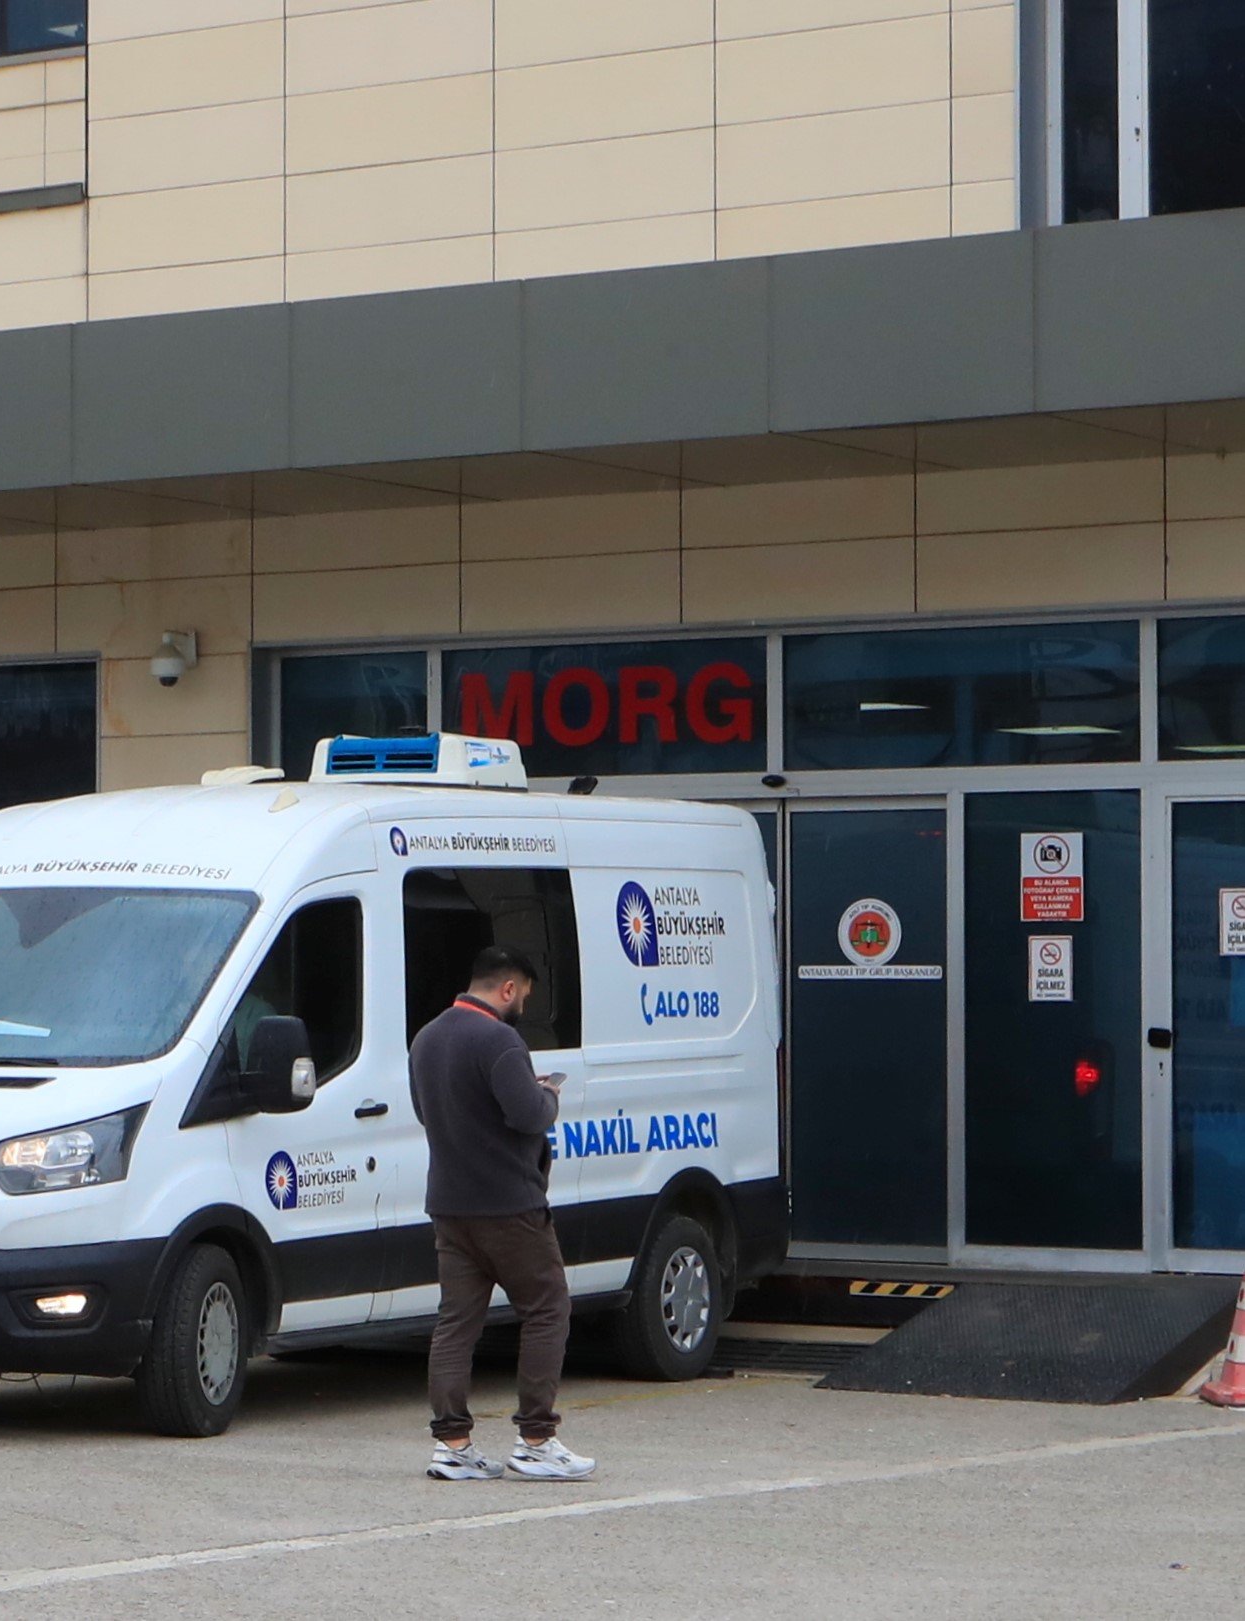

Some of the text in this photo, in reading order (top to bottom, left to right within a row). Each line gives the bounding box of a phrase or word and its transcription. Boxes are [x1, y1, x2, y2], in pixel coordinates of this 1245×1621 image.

[460, 661, 753, 747] MORG
[409, 832, 556, 854] ANTALYA BÜYÜKŞEHİR BELEDİYESİ
[33, 859, 139, 875] BÜYÜKŞEHİR
[142, 862, 233, 880] BELEDİYESİ
[654, 887, 700, 906] ANTALYA
[656, 911, 726, 939] BÜYÜKŞEHİR
[659, 941, 714, 965] BELEDİYESİ
[654, 991, 720, 1018] ALO 188
[562, 1109, 640, 1159] NAKİL
[645, 1112, 719, 1152] ARACI
[297, 1151, 335, 1167] ANTALYA
[298, 1165, 357, 1188] BÜYÜKŞEHİR
[298, 1188, 345, 1209] BELEDİYESİ
